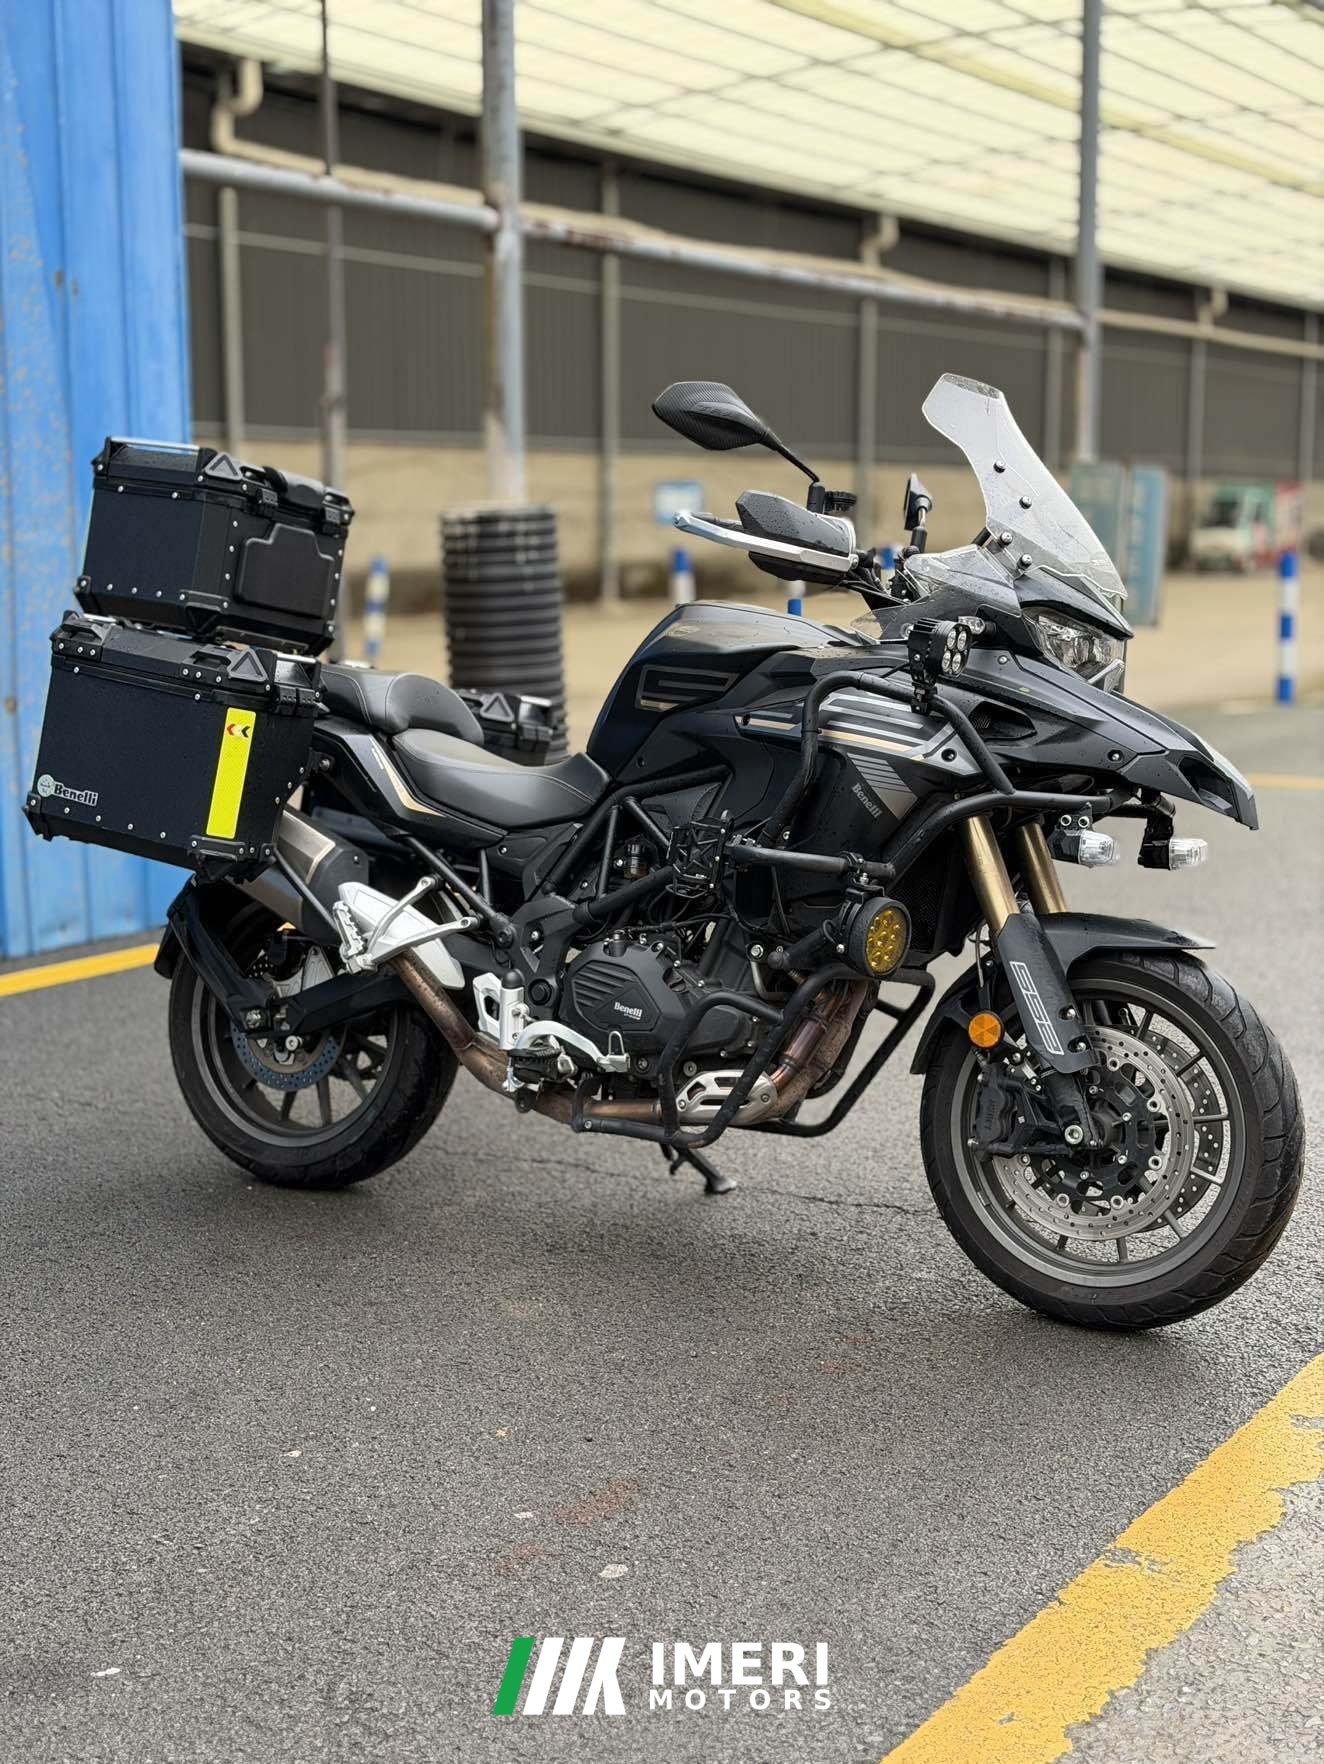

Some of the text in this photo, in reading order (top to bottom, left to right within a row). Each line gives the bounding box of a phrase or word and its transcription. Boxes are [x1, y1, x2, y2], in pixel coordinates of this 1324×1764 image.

[54, 782, 98, 805] Benelli
[852, 783, 882, 818] Benelli
[614, 1001, 643, 1017] Benelli
